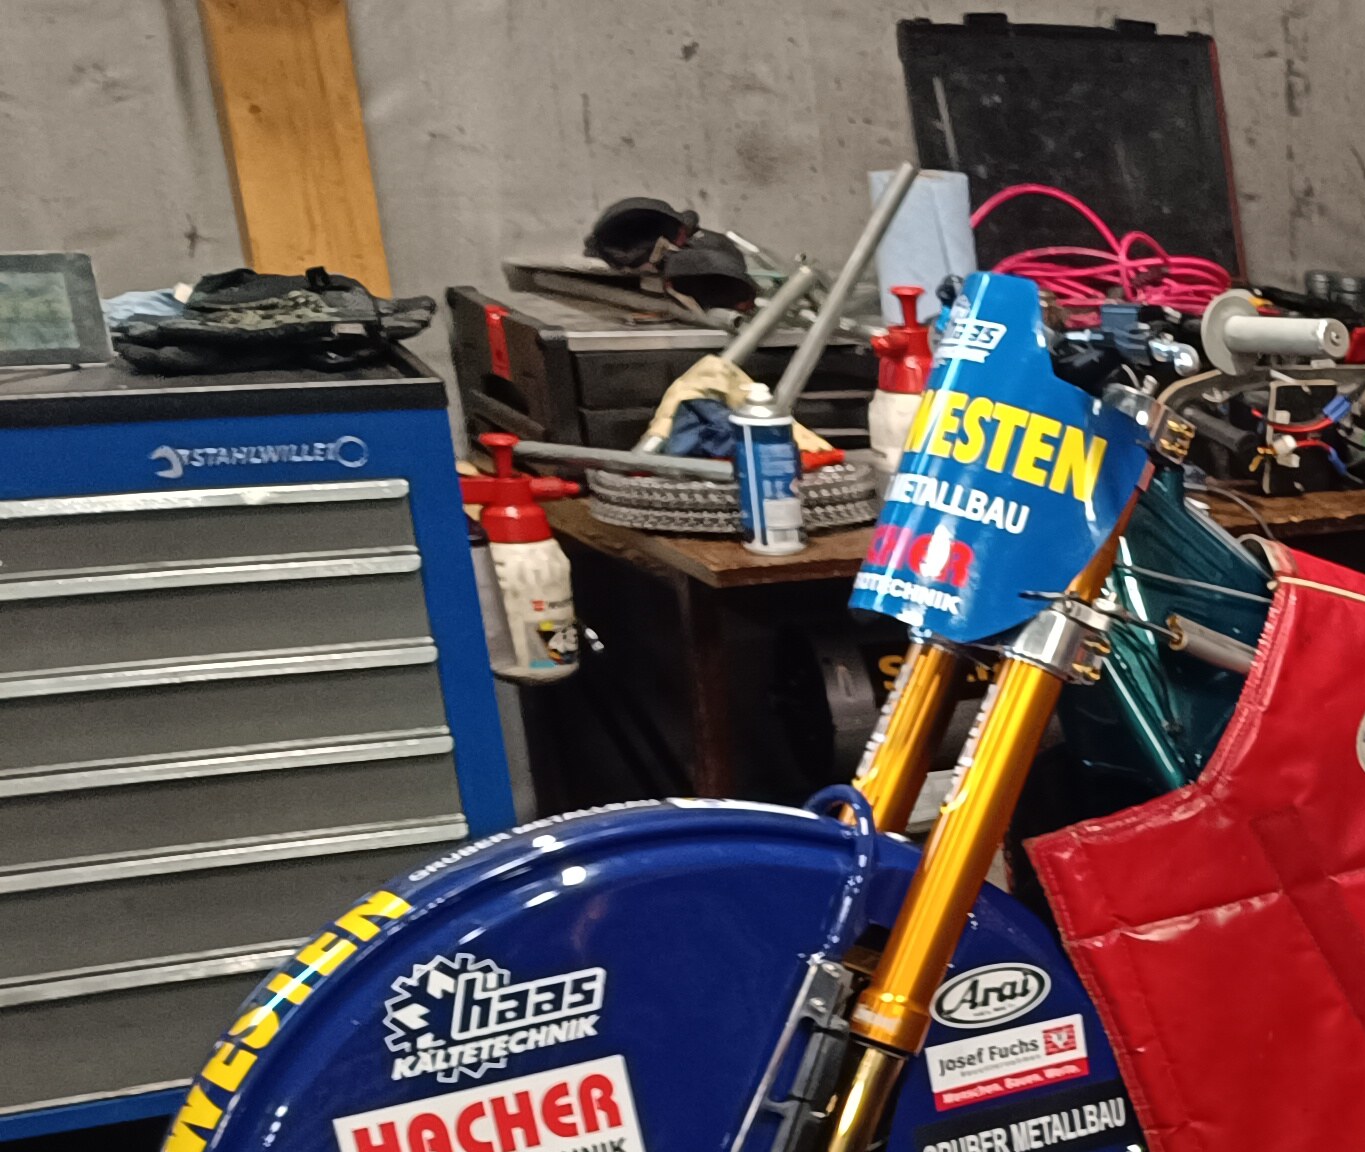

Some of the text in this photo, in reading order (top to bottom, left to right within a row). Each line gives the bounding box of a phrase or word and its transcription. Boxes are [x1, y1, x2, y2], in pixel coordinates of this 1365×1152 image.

[451, 967, 607, 1041] haas
[943, 972, 1031, 1015] Arai
[939, 1047, 985, 1077] Josef
[989, 1038, 1040, 1062] Fuchs
